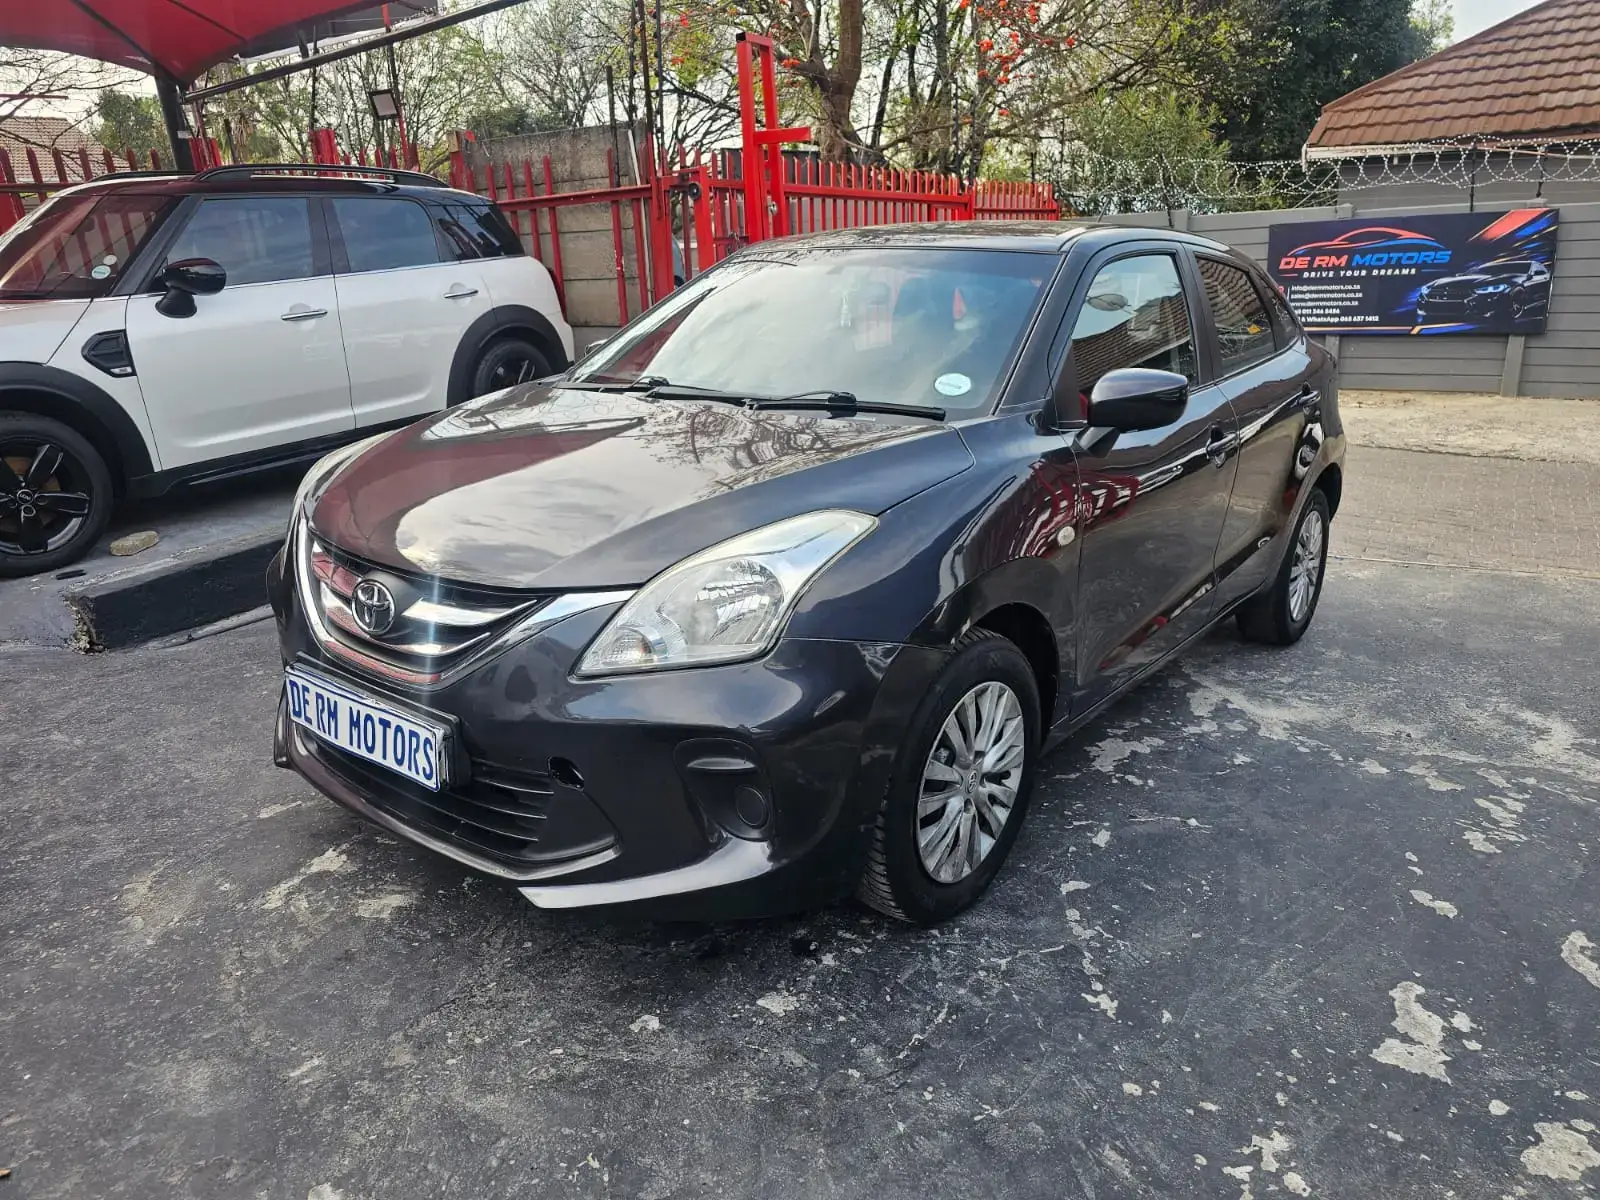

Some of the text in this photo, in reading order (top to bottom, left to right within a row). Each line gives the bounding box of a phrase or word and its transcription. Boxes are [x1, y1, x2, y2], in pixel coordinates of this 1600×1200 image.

[1279, 250, 1452, 270] DE RM MOTORS
[1372, 268, 1416, 276] DREAMS
[288, 679, 434, 781] DE RM MOTORS
